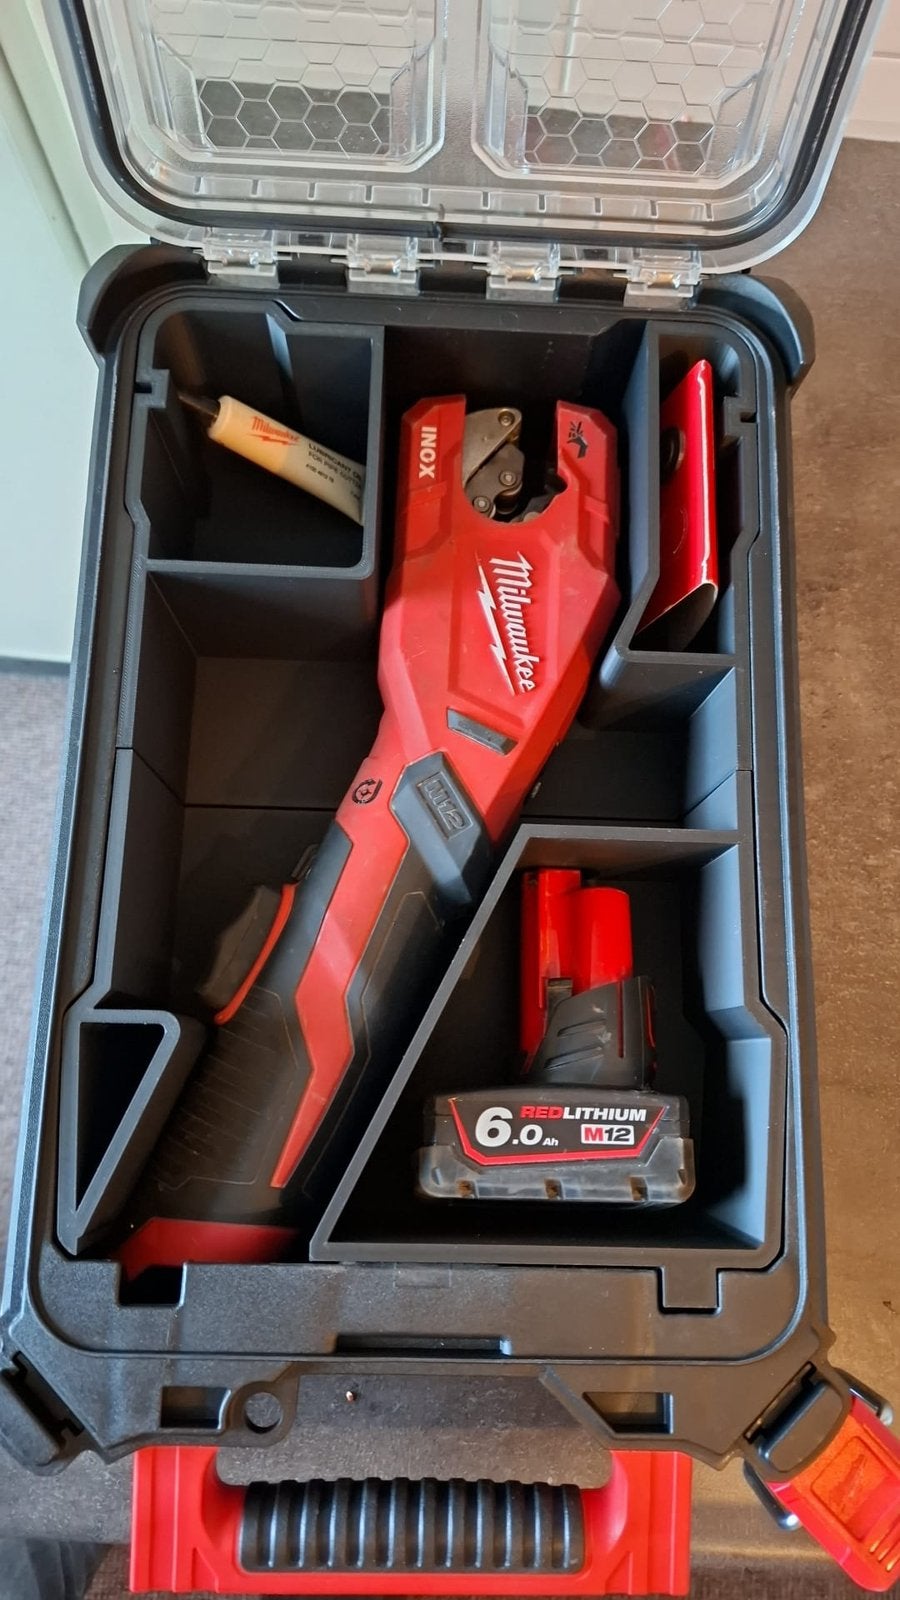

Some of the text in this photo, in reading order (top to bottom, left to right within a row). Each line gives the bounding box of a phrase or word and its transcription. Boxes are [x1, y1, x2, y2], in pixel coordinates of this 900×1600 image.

[419, 425, 438, 480] INOX
[489, 551, 540, 694] Milwaukee
[583, 1126, 632, 1143] M12
